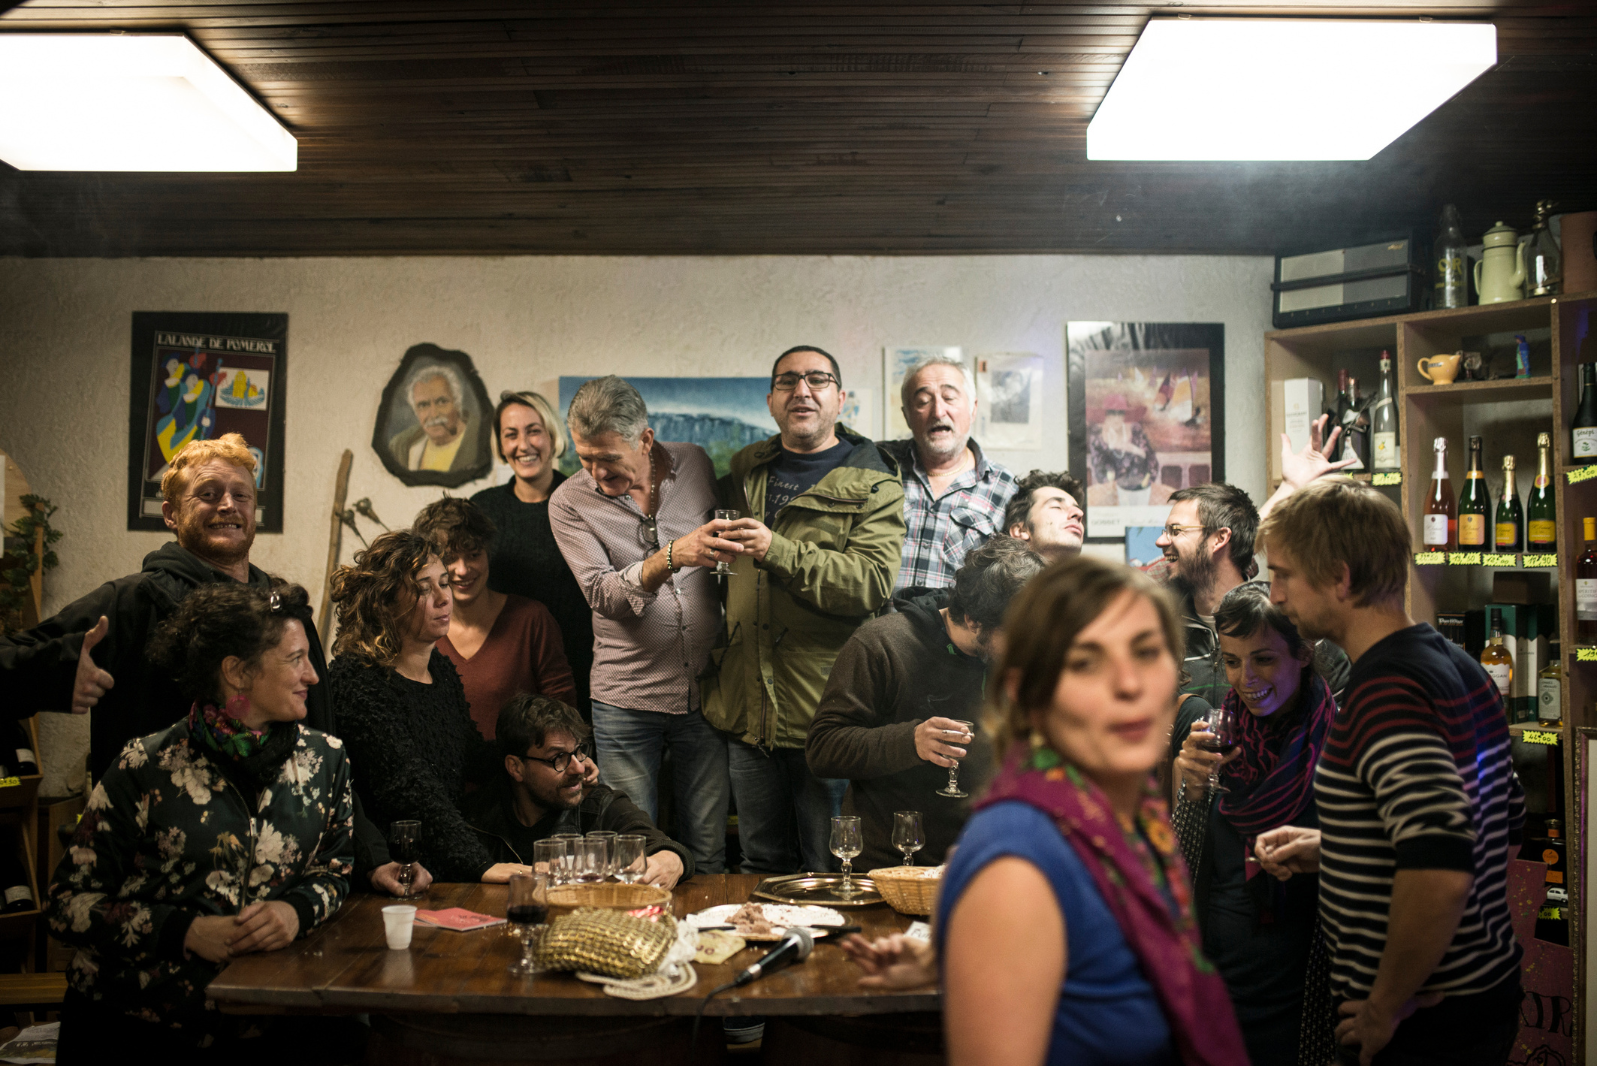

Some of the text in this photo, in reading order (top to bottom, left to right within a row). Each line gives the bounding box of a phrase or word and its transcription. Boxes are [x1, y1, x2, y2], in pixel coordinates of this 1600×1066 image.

[157, 333, 206, 348] LALANDE
[209, 337, 224, 350] DE
[768, 475, 800, 491] Finest
